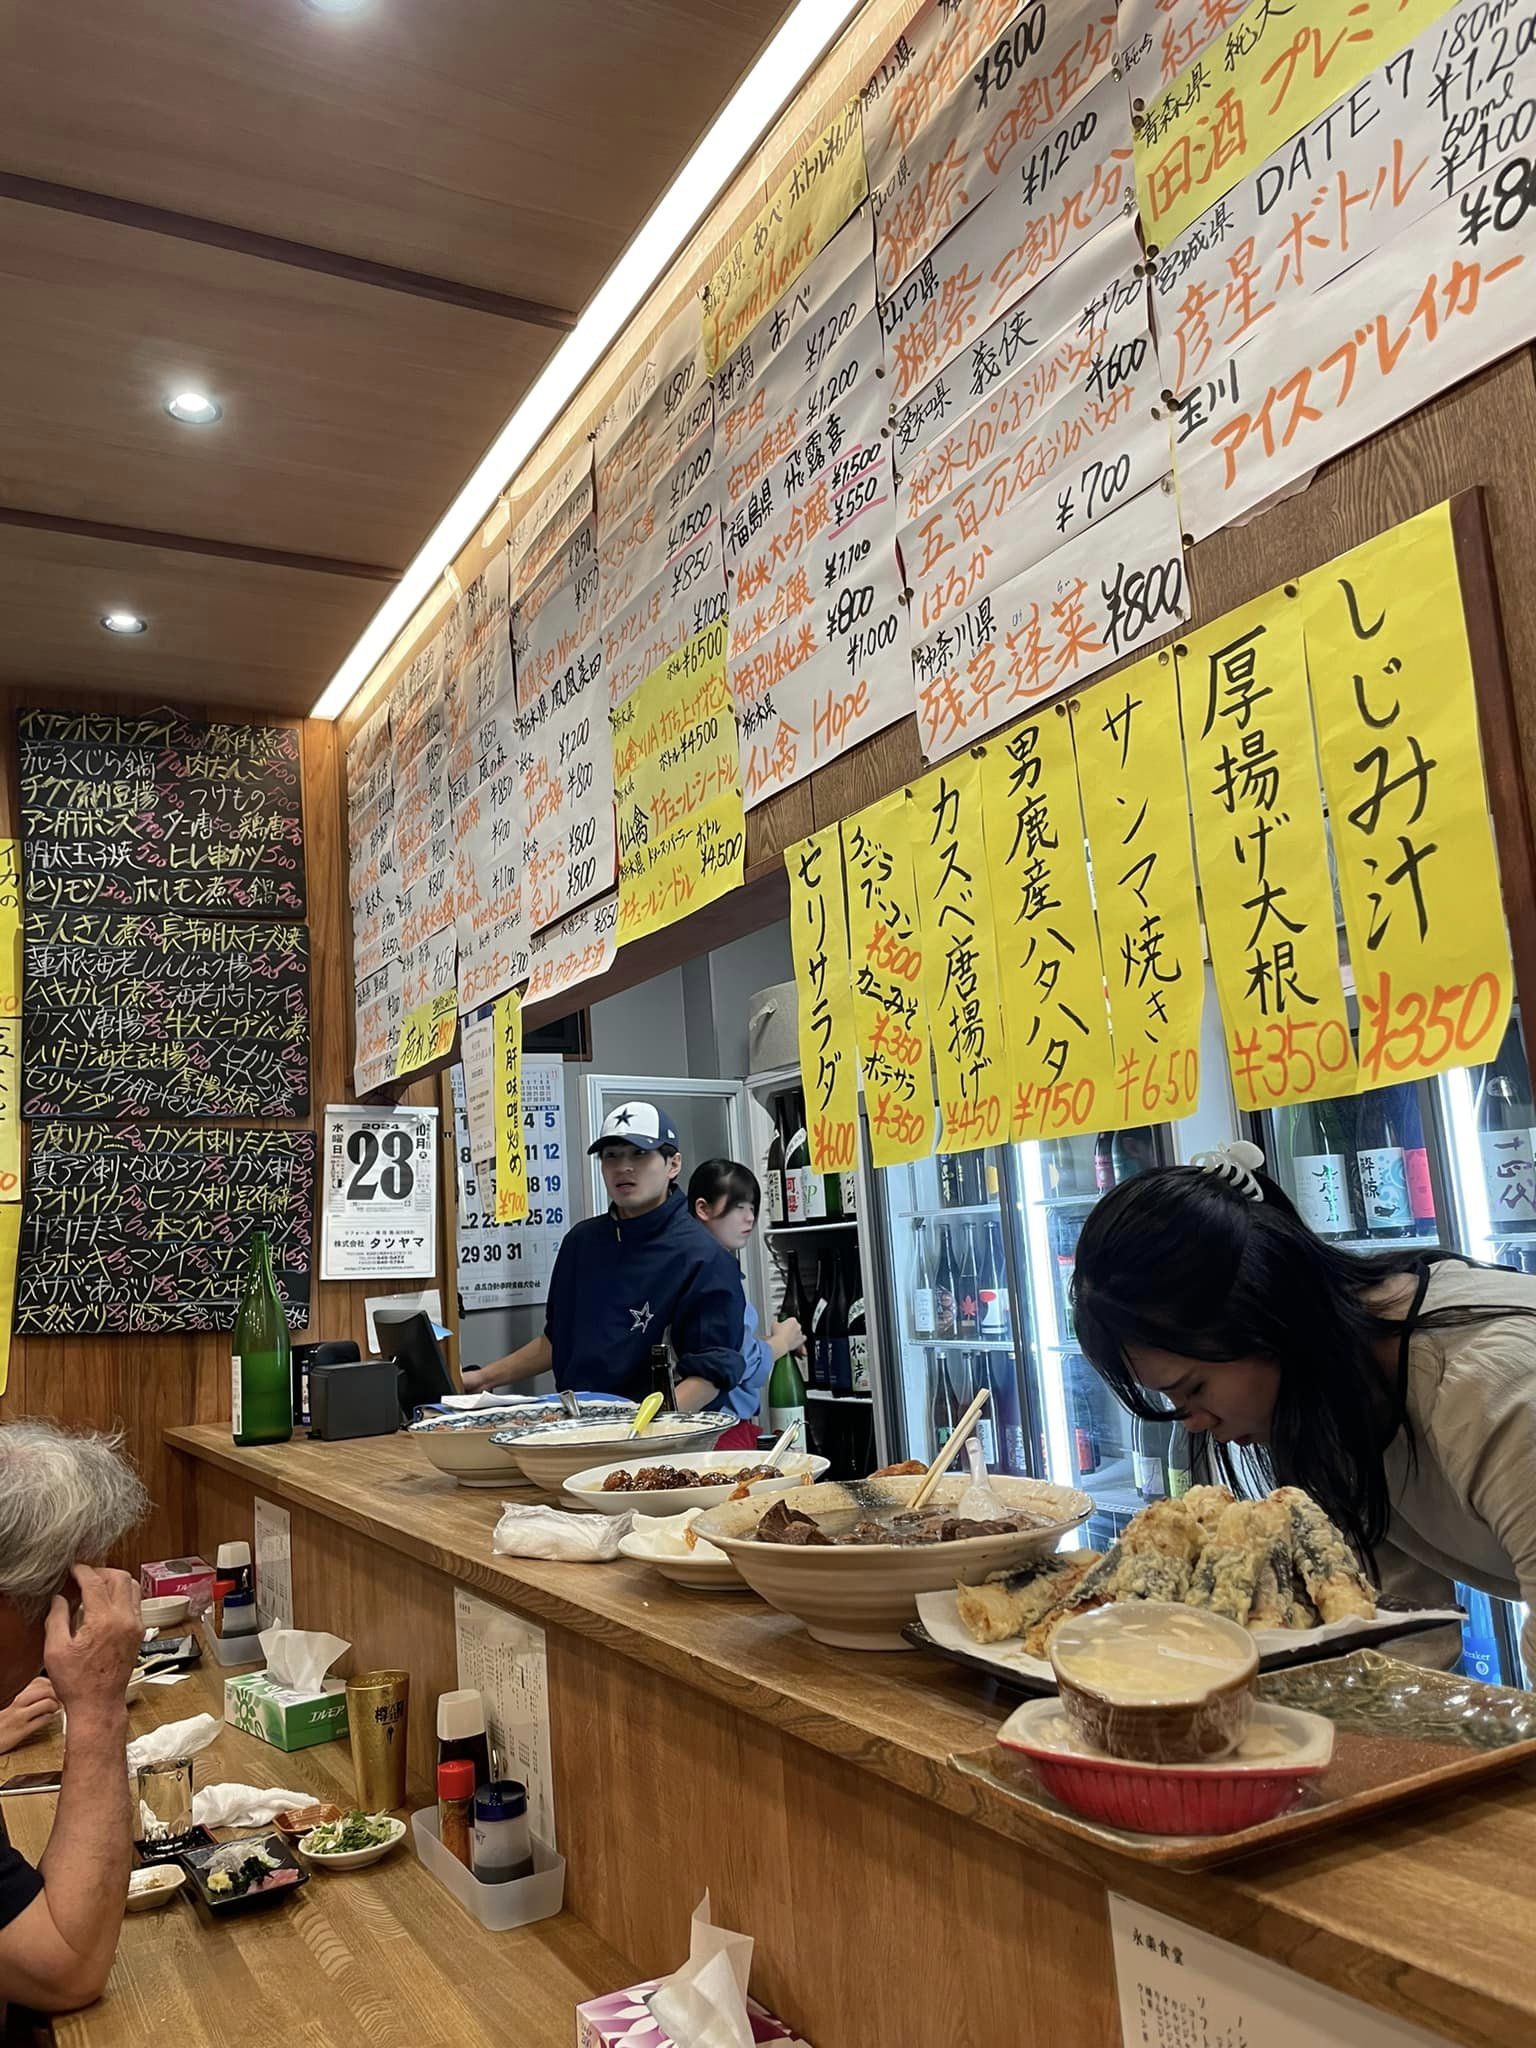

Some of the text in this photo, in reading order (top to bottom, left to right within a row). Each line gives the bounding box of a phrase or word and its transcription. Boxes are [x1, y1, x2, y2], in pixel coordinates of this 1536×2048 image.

[974, 3, 1047, 112] ¥800
[1022, 111, 1097, 206] ¥1,200
[1148, 86, 1248, 222] 田酒
[1154, 201, 1235, 296] 宮城県
[1256, 80, 1381, 215] DATE
[769, 285, 811, 353] あべ
[804, 303, 857, 374] ¥1,200
[663, 360, 697, 420] ¥800
[806, 360, 859, 427] ¥1,200
[1085, 338, 1148, 403] ¥600
[1210, 254, 1526, 490] アイスブレイカー
[1175, 358, 1240, 444] 玉川
[670, 447, 711, 511] ¥1,200
[835, 476, 878, 527] ¥550
[1056, 453, 1131, 533] ¥700
[574, 564, 600, 613] ¥850
[671, 540, 714, 600] ¥850
[826, 585, 874, 643] ¥800
[1101, 557, 1183, 655] ¥800
[812, 679, 871, 759] Hope
[1337, 578, 1439, 951] しじみ汁
[567, 816, 597, 859] ¥800
[1200, 624, 1320, 1016] 厚揚げ大根
[566, 856, 597, 900] ¥800
[700, 832, 743, 878] ¥4,500
[1101, 692, 1182, 1043] サンマ焼き
[1004, 725, 1090, 1089] 男鹿産ハタハタ
[866, 920, 923, 983] ¥500
[930, 777, 992, 1112] カスベ唐揚げ
[868, 1011, 923, 1066] ¥350
[1362, 971, 1500, 1083] ¥350
[861, 1051, 916, 1102] ポテサラ
[1116, 1048, 1198, 1122] ¥650
[1234, 1013, 1349, 1105] ¥350
[361, 1122, 401, 1130] 2024
[524, 1113, 535, 1128] 4
[545, 1112, 556, 1128] 5
[873, 1092, 926, 1146] ¥350
[946, 1094, 1000, 1151] ¥450
[1013, 1078, 1096, 1137] ¥750
[332, 1122, 344, 1155] 水曜日
[346, 1130, 415, 1201] 23
[525, 1145, 538, 1160] 11
[543, 1143, 560, 1160] 12
[813, 1114, 856, 1171] ¥600
[499, 1189, 526, 1218] ¥700
[545, 1176, 561, 1192] 19
[370, 1237, 425, 1249] タツヤマ
[525, 1208, 543, 1226] 25
[546, 1207, 563, 1225] 26
[461, 1246, 480, 1263] 29
[483, 1244, 502, 1262] 30
[507, 1242, 522, 1260] 31
